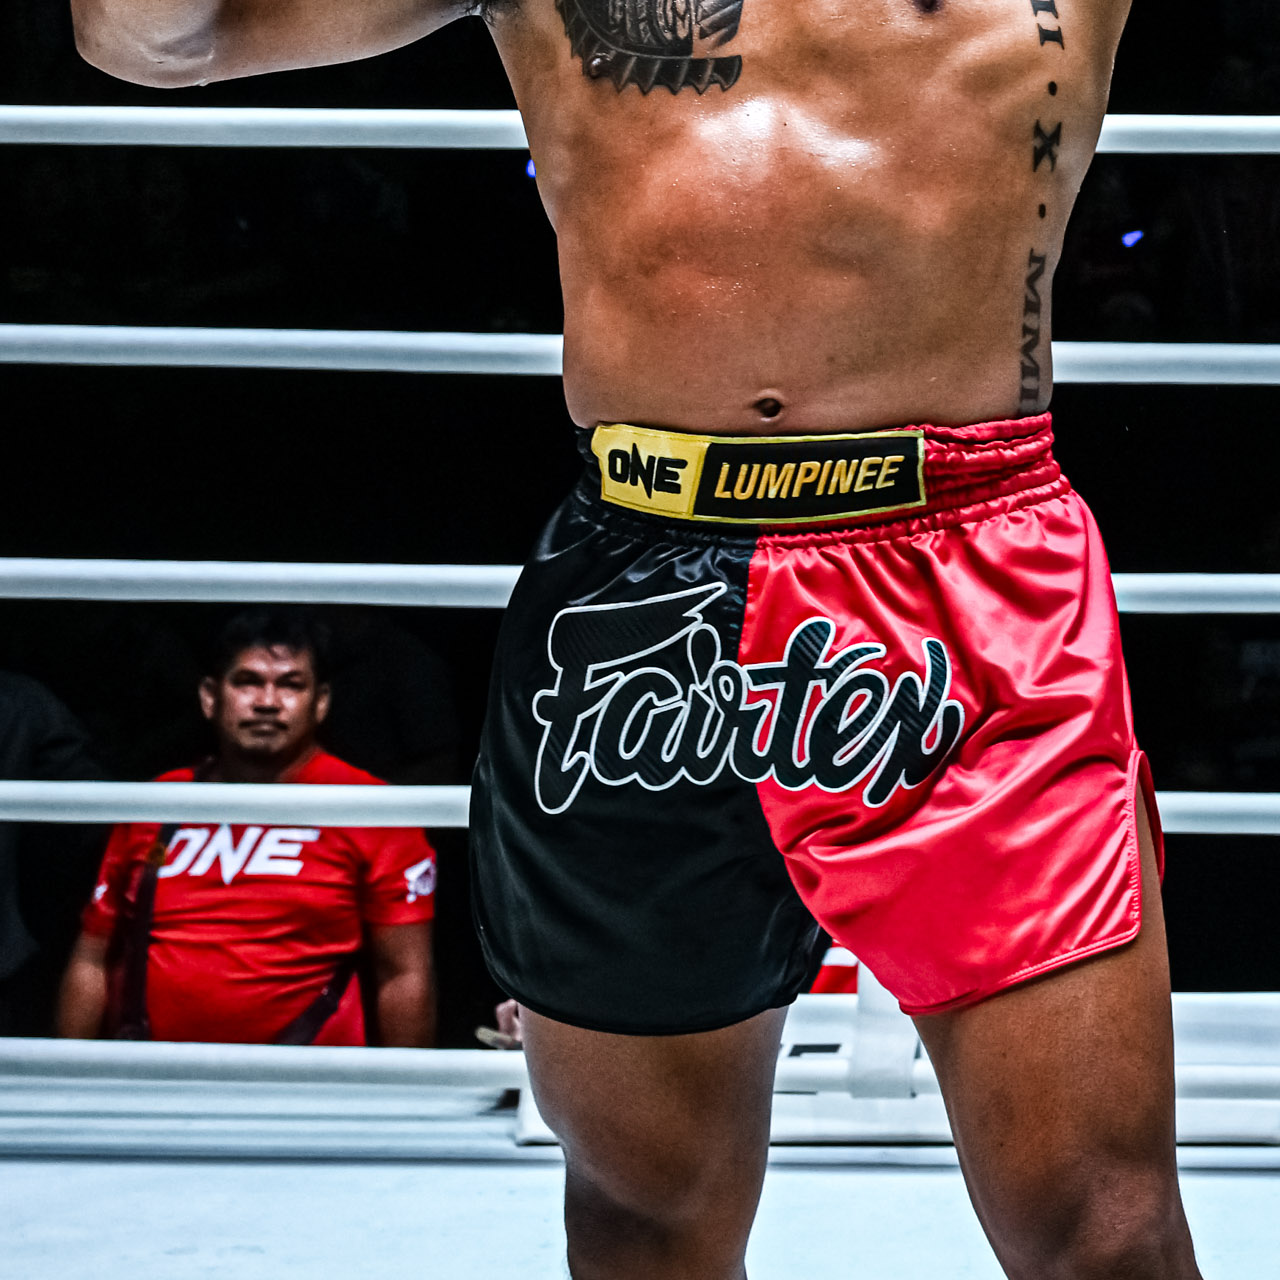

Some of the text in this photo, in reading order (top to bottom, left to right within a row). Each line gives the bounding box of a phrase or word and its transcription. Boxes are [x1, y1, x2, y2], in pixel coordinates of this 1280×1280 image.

[1032, 118, 1063, 173] X
[607, 442, 906, 499] ONE LUMPINEE
[532, 581, 966, 815] Fairtex
